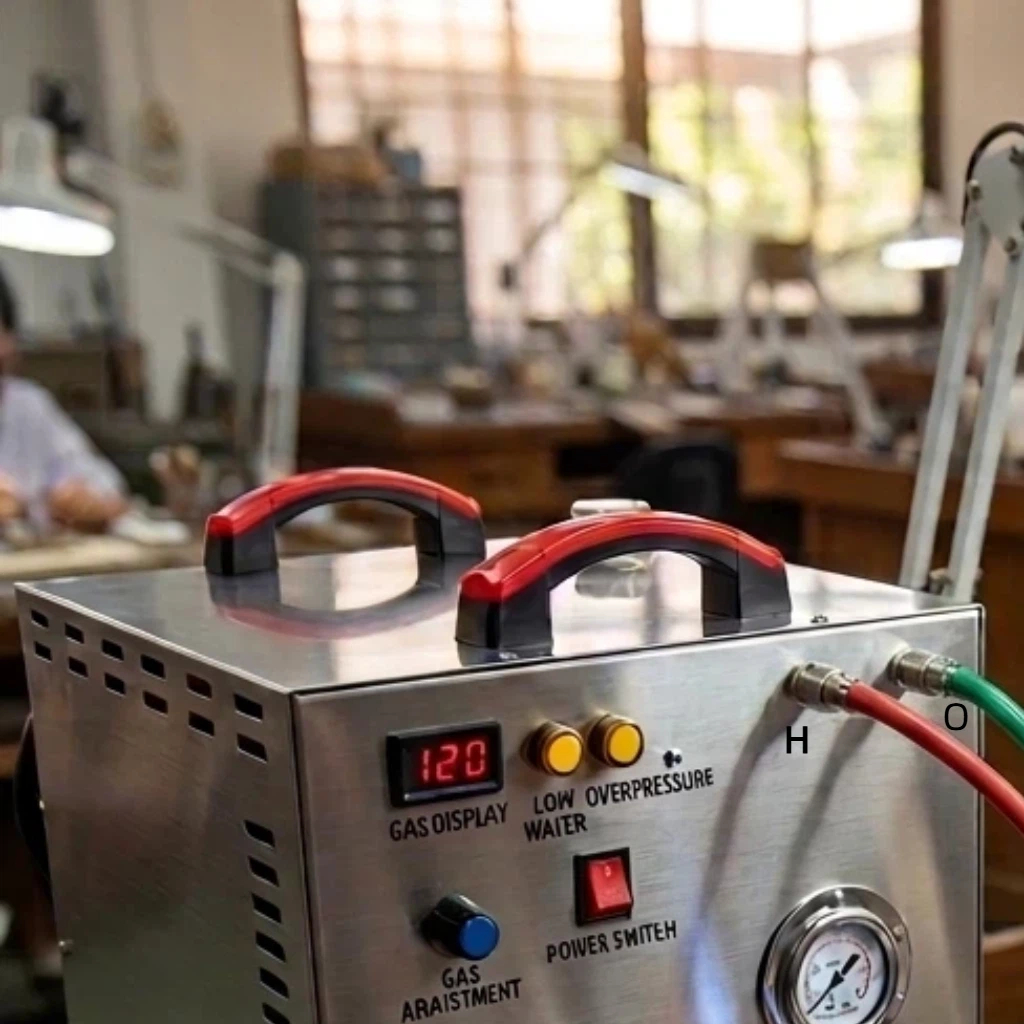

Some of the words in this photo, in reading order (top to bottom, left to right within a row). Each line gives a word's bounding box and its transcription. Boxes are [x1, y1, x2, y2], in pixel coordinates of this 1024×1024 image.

[420, 738, 487, 782] 120
[534, 788, 575, 815] LOW
[585, 767, 715, 807] OVERPRESSURE
[389, 817, 430, 842] GAS
[441, 964, 481, 989] GAS
